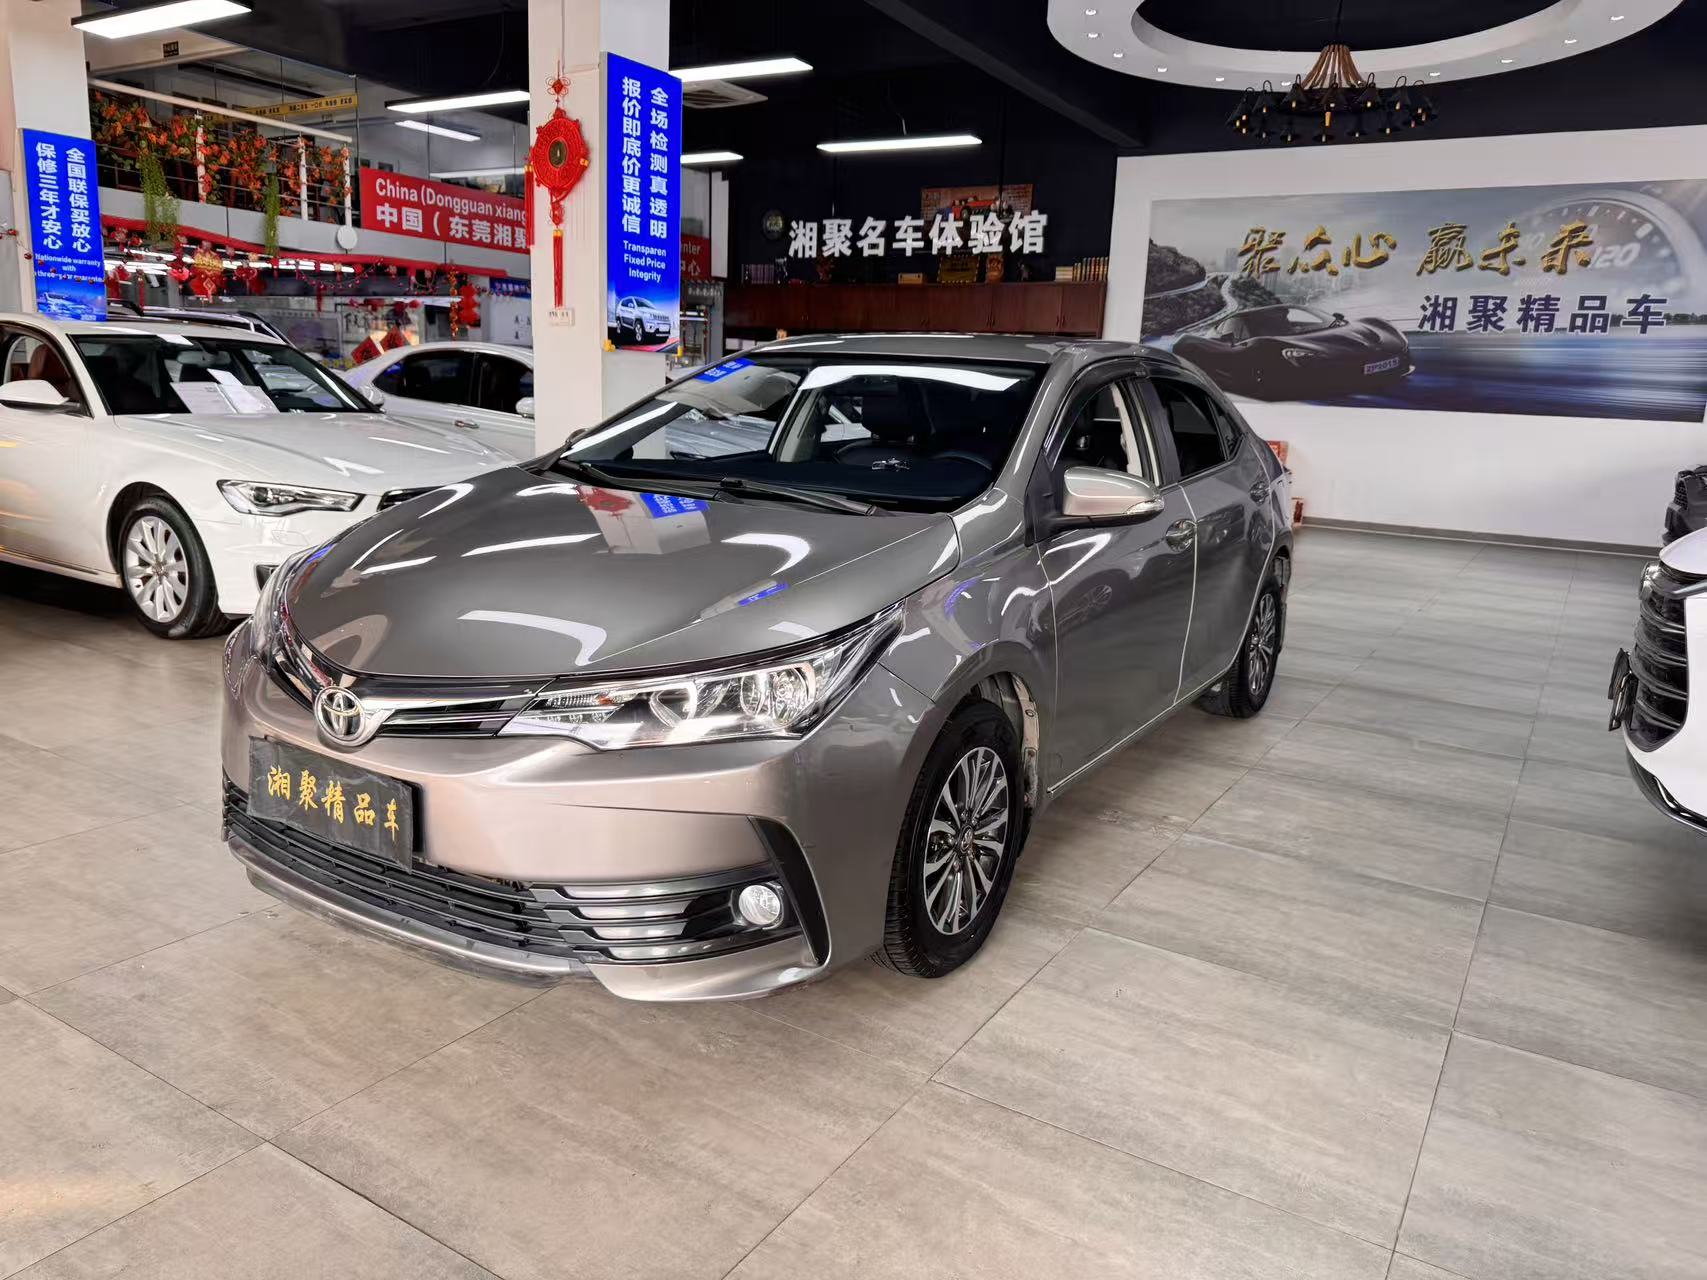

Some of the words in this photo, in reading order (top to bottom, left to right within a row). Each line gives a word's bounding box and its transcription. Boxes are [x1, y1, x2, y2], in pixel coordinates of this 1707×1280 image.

[622, 76, 641, 234] 报价即底价更诚信
[649, 87, 669, 239] 全场检测真透明
[35, 142, 63, 250] 保修三年才安心
[66, 147, 92, 253] 全国联保买放心
[375, 178, 418, 202] China
[421, 185, 493, 216] (Dongguan
[623, 240, 667, 257] Transparen
[788, 210, 1049, 258] 湘聚名车体验馆
[1238, 225, 1397, 280] 聚众心
[1416, 220, 1594, 276] 赢未来
[35, 253, 72, 263] Nationwide
[73, 258, 101, 267] warranty
[62, 264, 76, 272] with
[624, 254, 645, 267] Fixed
[646, 256, 666, 270] Price
[629, 267, 662, 283] Integrity
[1417, 293, 1668, 335] 湘聚精品车
[267, 764, 400, 842] 湘聚精品车
